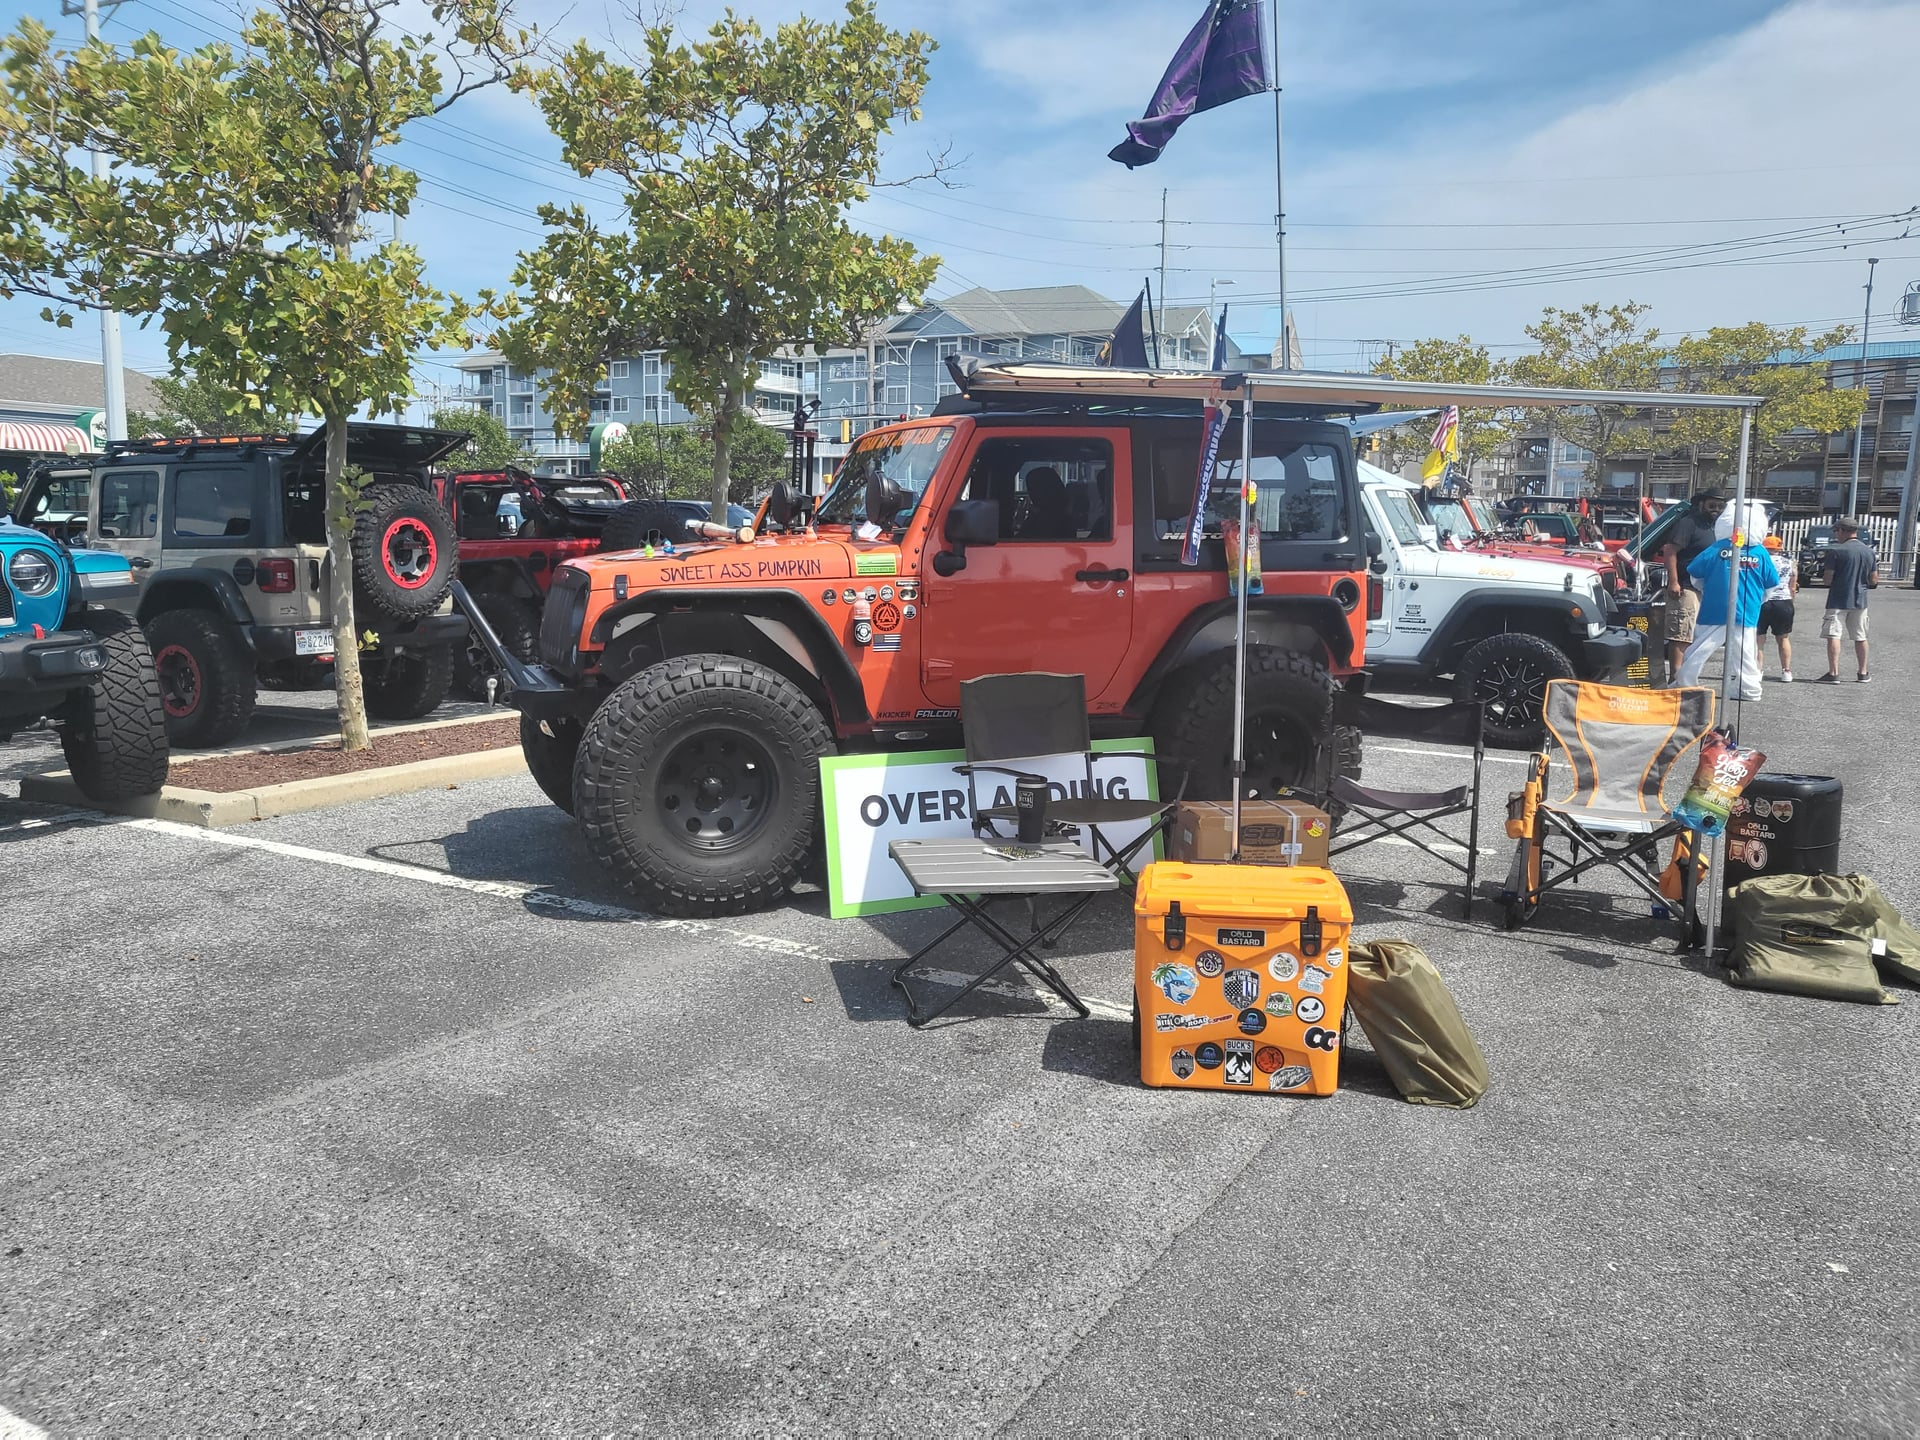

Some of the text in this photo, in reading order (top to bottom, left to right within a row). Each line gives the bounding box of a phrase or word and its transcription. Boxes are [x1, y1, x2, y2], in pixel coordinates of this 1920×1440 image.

[661, 558, 822, 582] SWEET ASS PUMPKIN
[916, 709, 958, 718] FALCON
[1714, 754, 1748, 779] Hoop
[1713, 770, 1738, 789] Tea
[1747, 822, 1768, 831] COLD
[1740, 828, 1775, 840] BASTARD
[1230, 930, 1253, 938] COLD
[1222, 937, 1261, 946] BASTARD
[1266, 1001, 1291, 1011] JOE'S
[1227, 1040, 1252, 1050] BUCK'S
